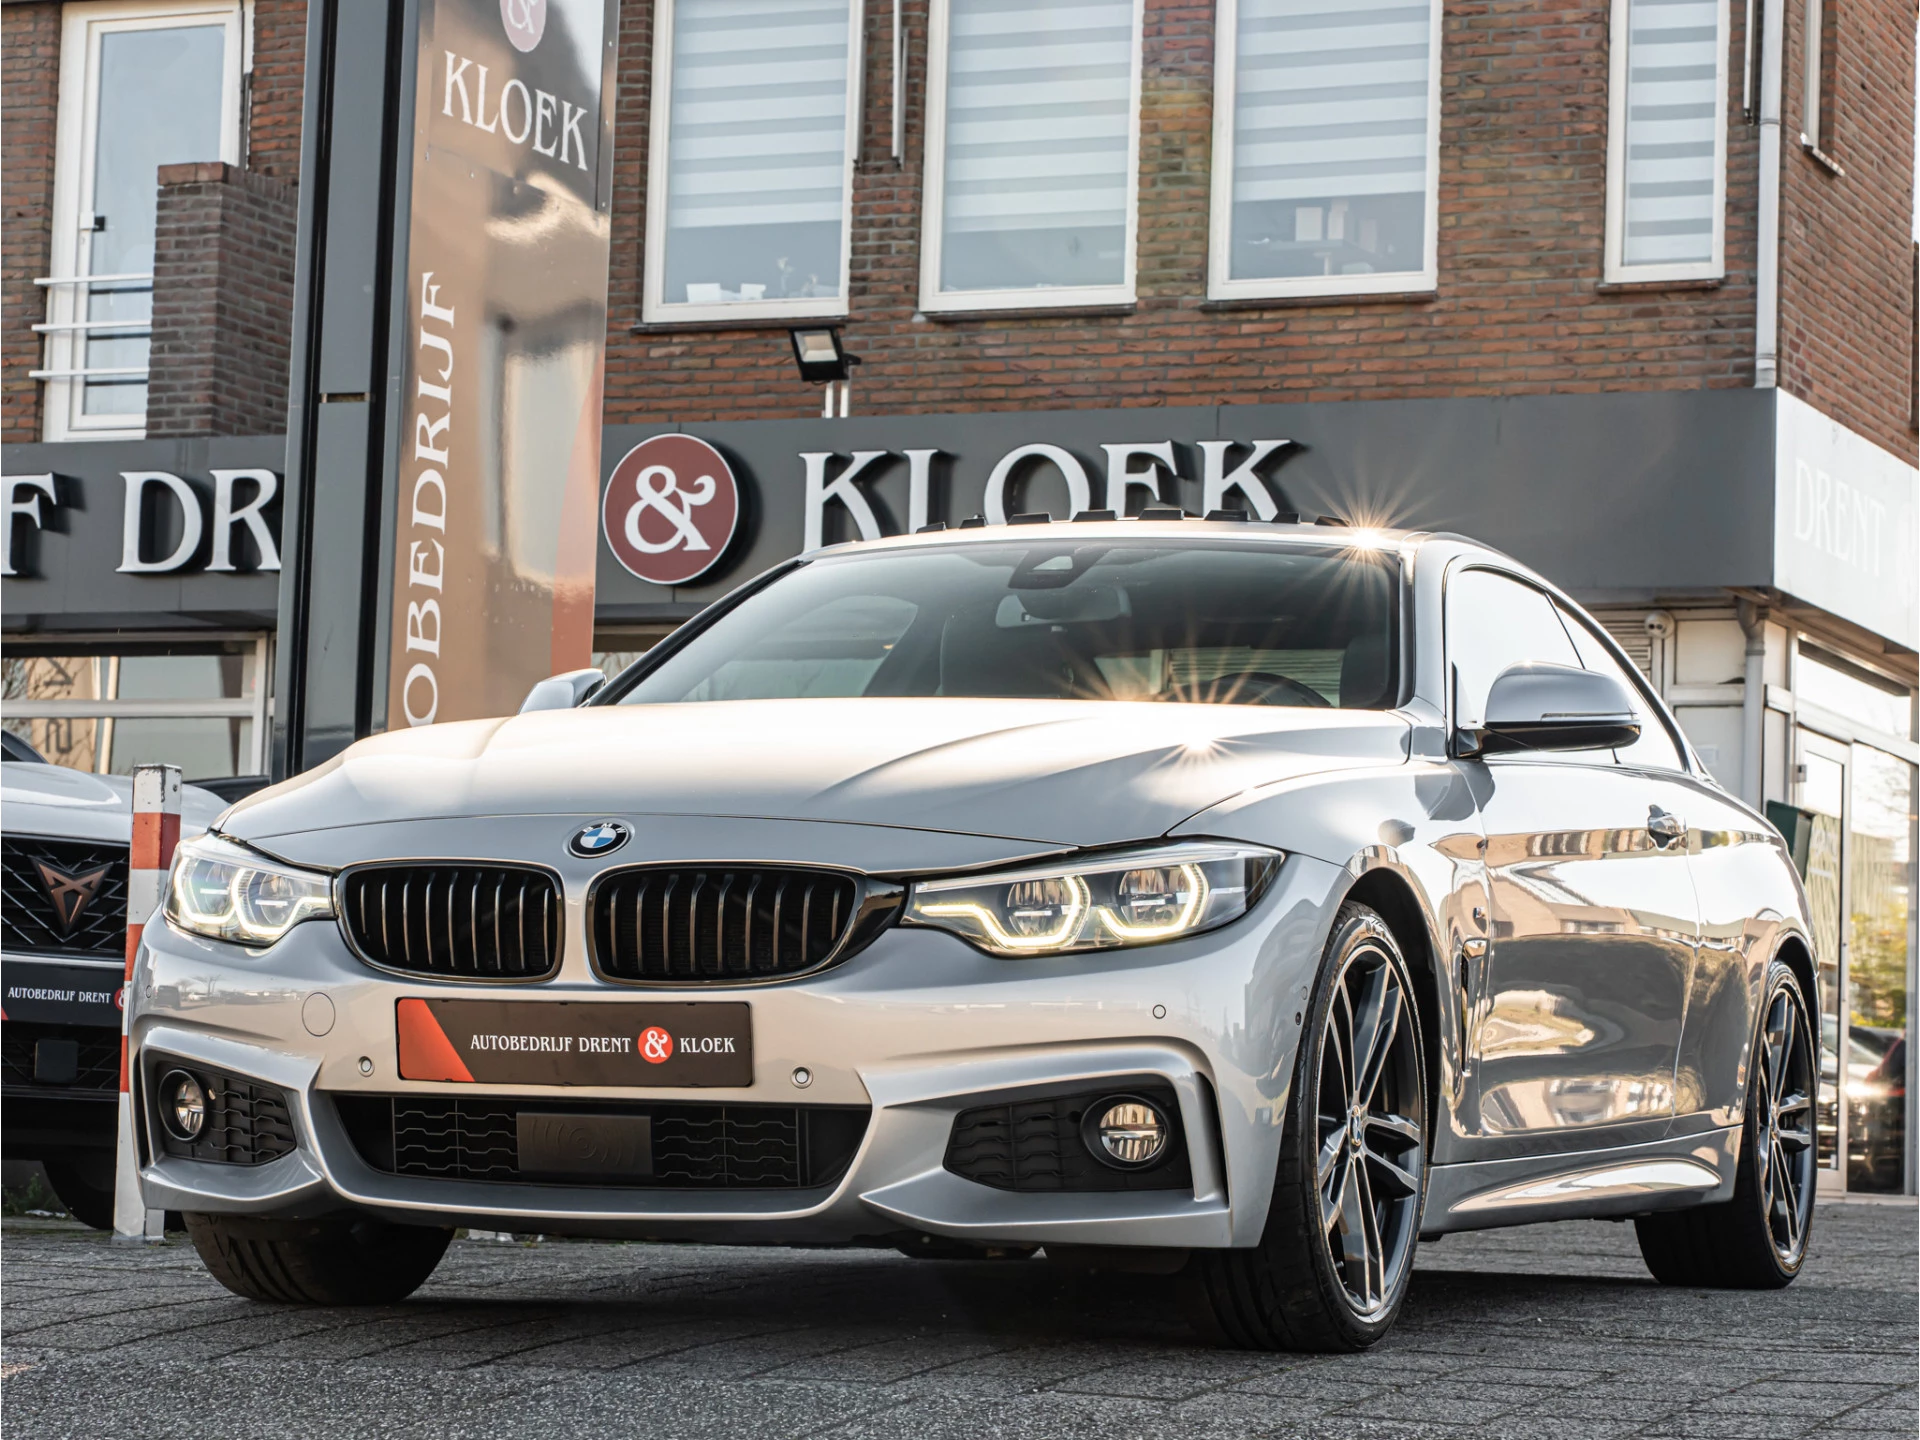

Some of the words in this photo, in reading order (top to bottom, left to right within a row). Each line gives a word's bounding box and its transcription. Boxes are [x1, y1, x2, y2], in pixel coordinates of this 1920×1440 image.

[442, 50, 588, 171] KLOEK
[624, 464, 717, 554] &
[1794, 456, 1886, 577] DRENT
[8, 986, 75, 1002] AUTOBEDRIJF
[78, 991, 111, 1004] DRENT
[470, 1034, 573, 1052] AUTOBEDRIJF
[578, 1037, 631, 1053] DRENT
[644, 1029, 668, 1058] &
[680, 1038, 735, 1053] KLOEK
